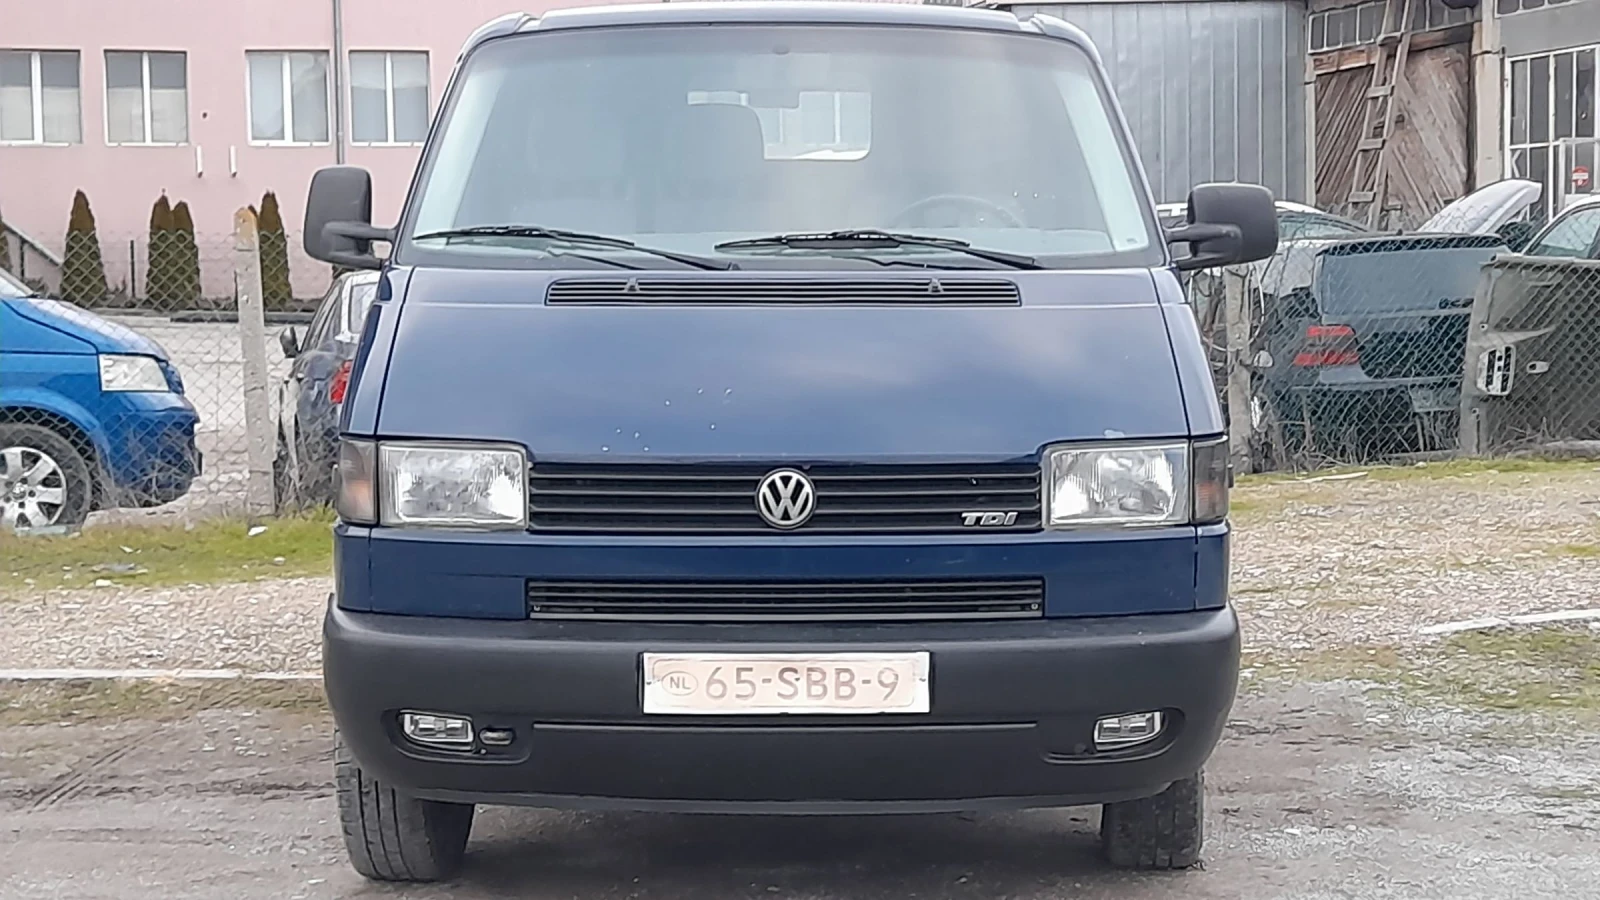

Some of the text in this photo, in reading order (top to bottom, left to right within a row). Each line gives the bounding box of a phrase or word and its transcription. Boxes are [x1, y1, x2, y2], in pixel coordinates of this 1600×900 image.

[961, 511, 1018, 525] TDI
[669, 666, 900, 702] NL 65-SBB-9
